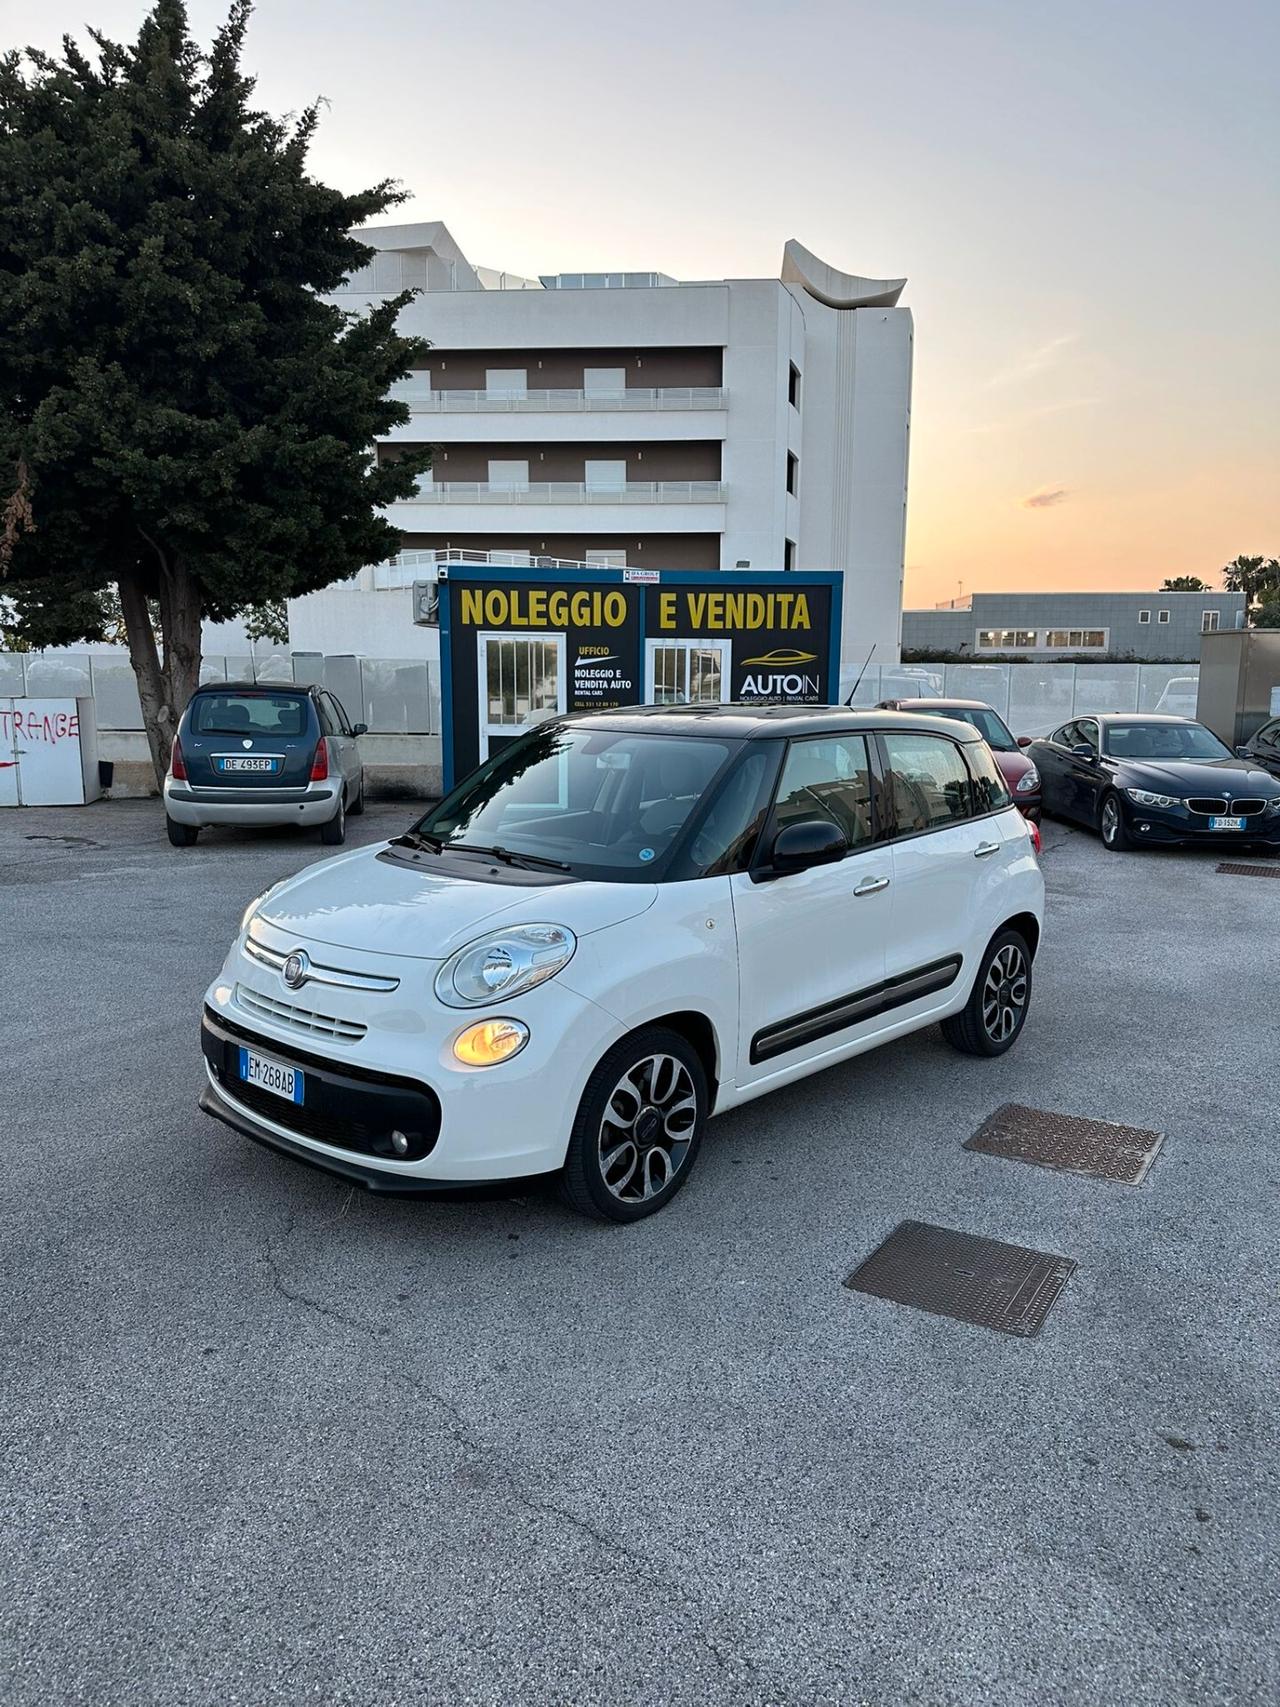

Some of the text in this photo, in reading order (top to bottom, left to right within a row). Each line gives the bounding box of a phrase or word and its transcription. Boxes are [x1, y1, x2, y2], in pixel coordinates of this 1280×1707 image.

[461, 589, 811, 629] NOLEGGIO E VENDITA
[579, 647, 610, 655] UFFICIO
[574, 669, 621, 678] NOLEGGIO E
[574, 680, 632, 689] VENDITA AUTO
[740, 674, 820, 695] AUTOIN
[225, 759, 271, 769] DE 493EP
